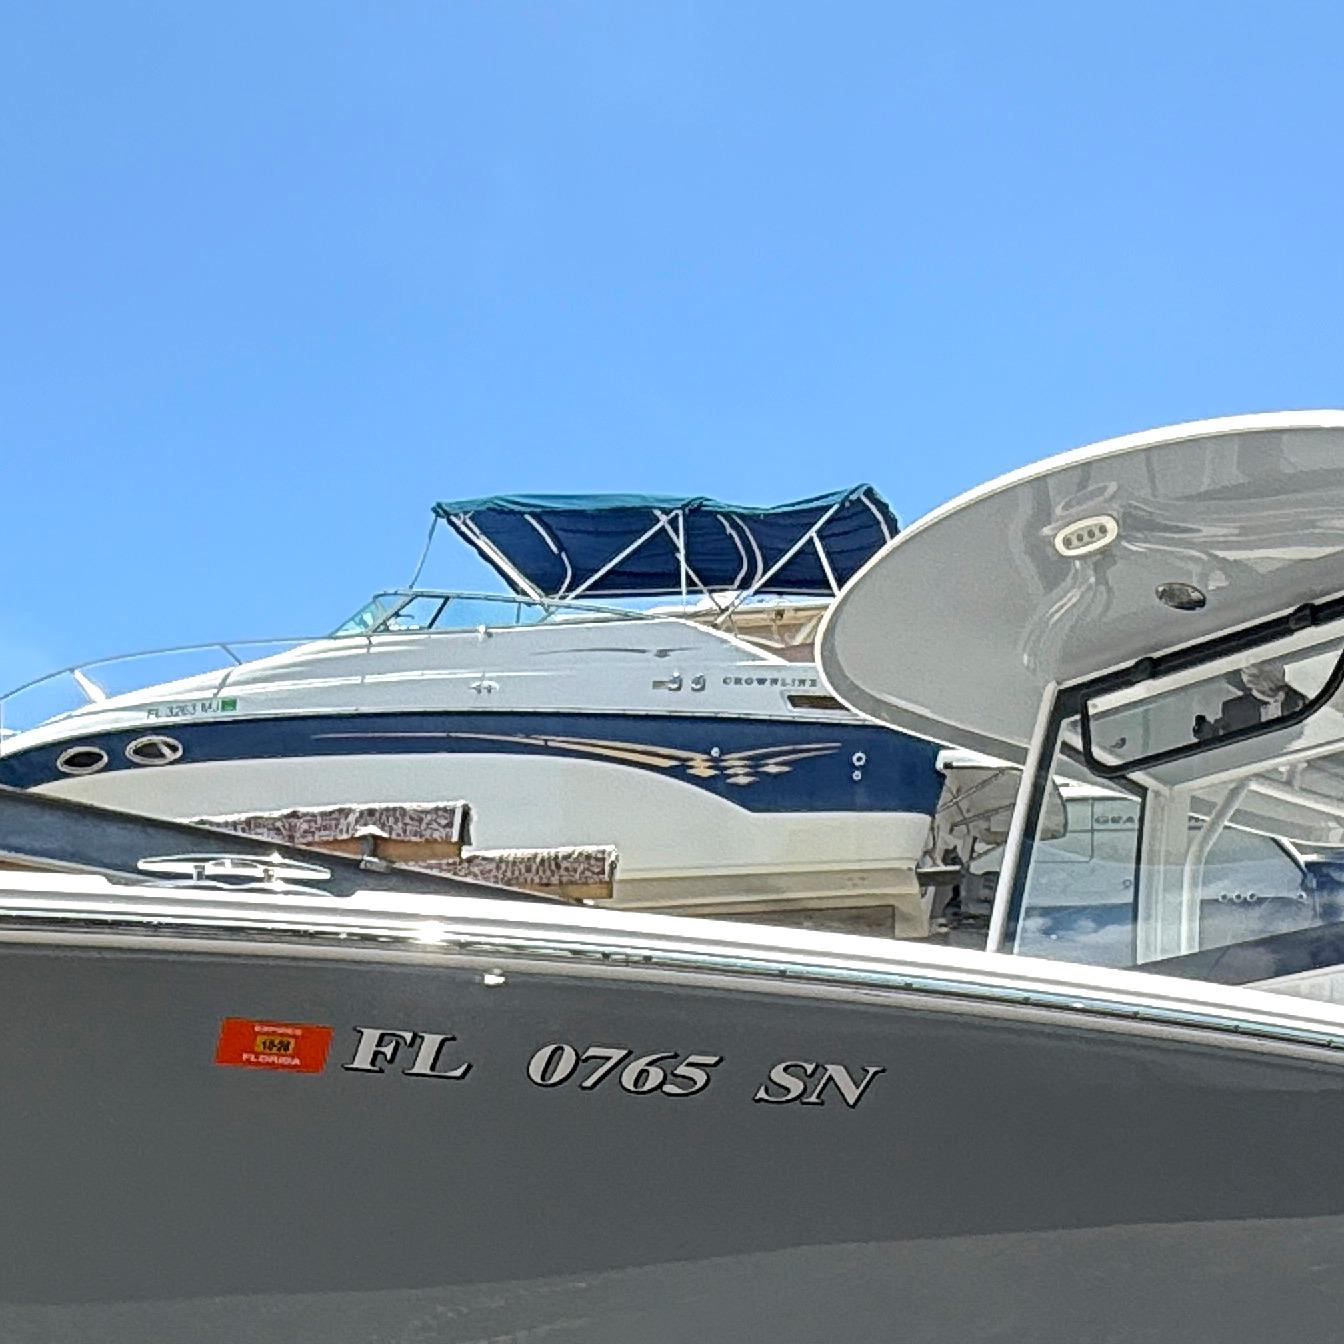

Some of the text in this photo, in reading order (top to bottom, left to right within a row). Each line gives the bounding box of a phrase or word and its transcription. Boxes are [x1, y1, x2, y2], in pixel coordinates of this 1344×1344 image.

[722, 676, 817, 688] CROWNLINE
[341, 1025, 887, 1109] FL 0765 SN
